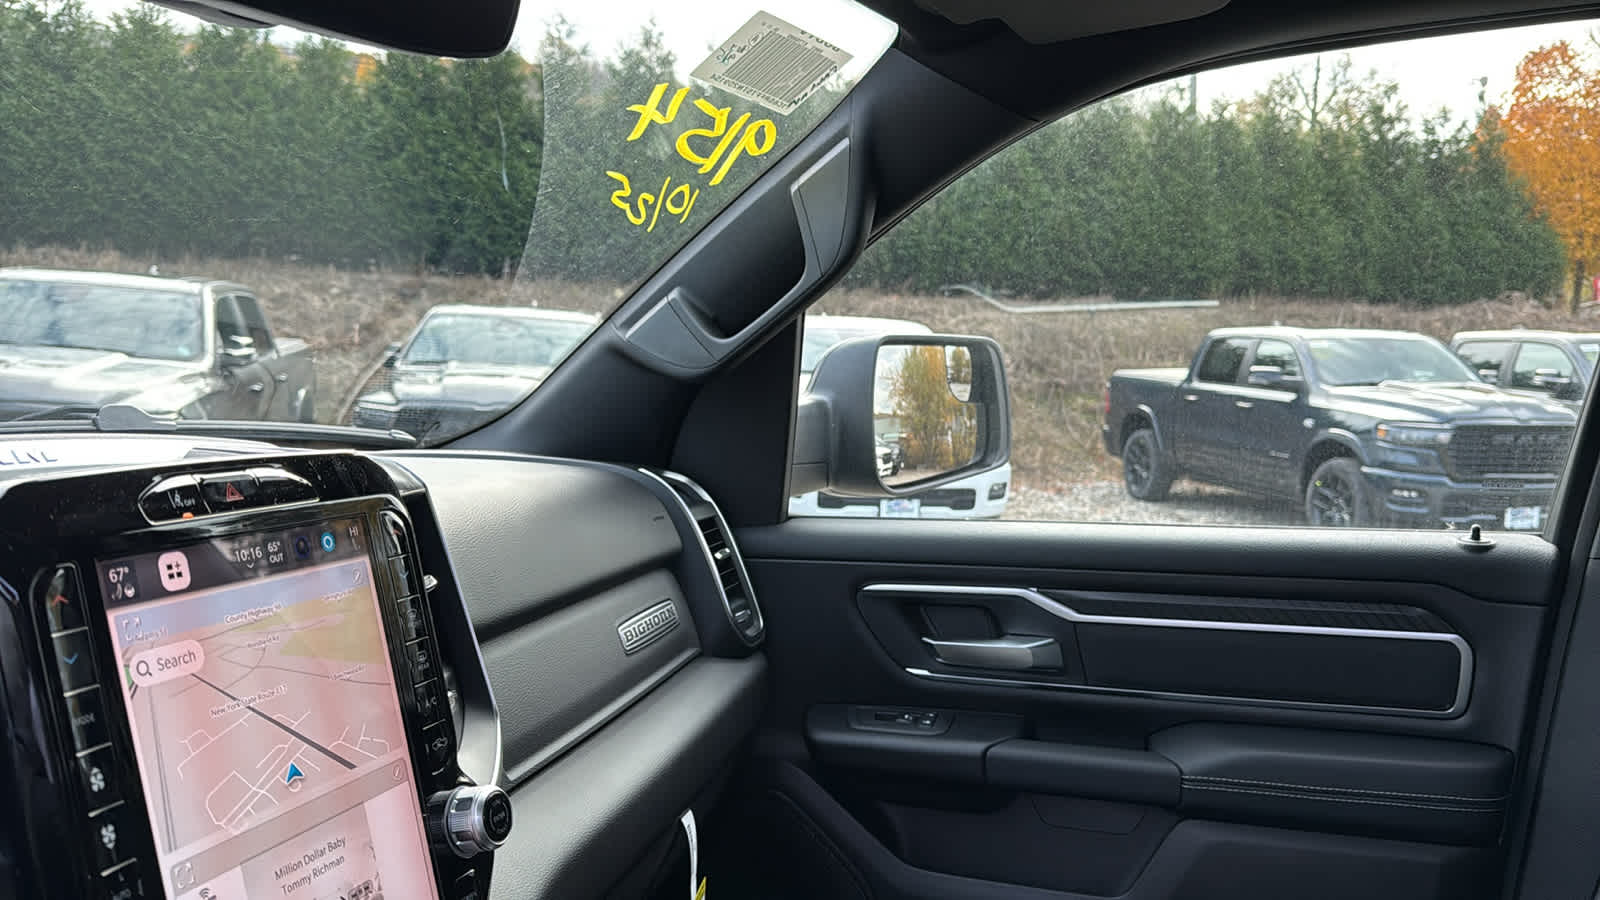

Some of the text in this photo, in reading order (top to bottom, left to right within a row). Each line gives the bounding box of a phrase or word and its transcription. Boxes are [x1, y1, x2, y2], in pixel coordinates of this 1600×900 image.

[235, 547, 263, 564] 10:16
[269, 553, 284, 563] OUT
[224, 612, 247, 625] County
[247, 606, 273, 621] Highway
[157, 649, 197, 672] Search
[210, 705, 226, 716] New
[226, 702, 241, 713] York
[275, 837, 346, 880] Million Dollar Baby
[282, 856, 344, 895] Tommy Richman
